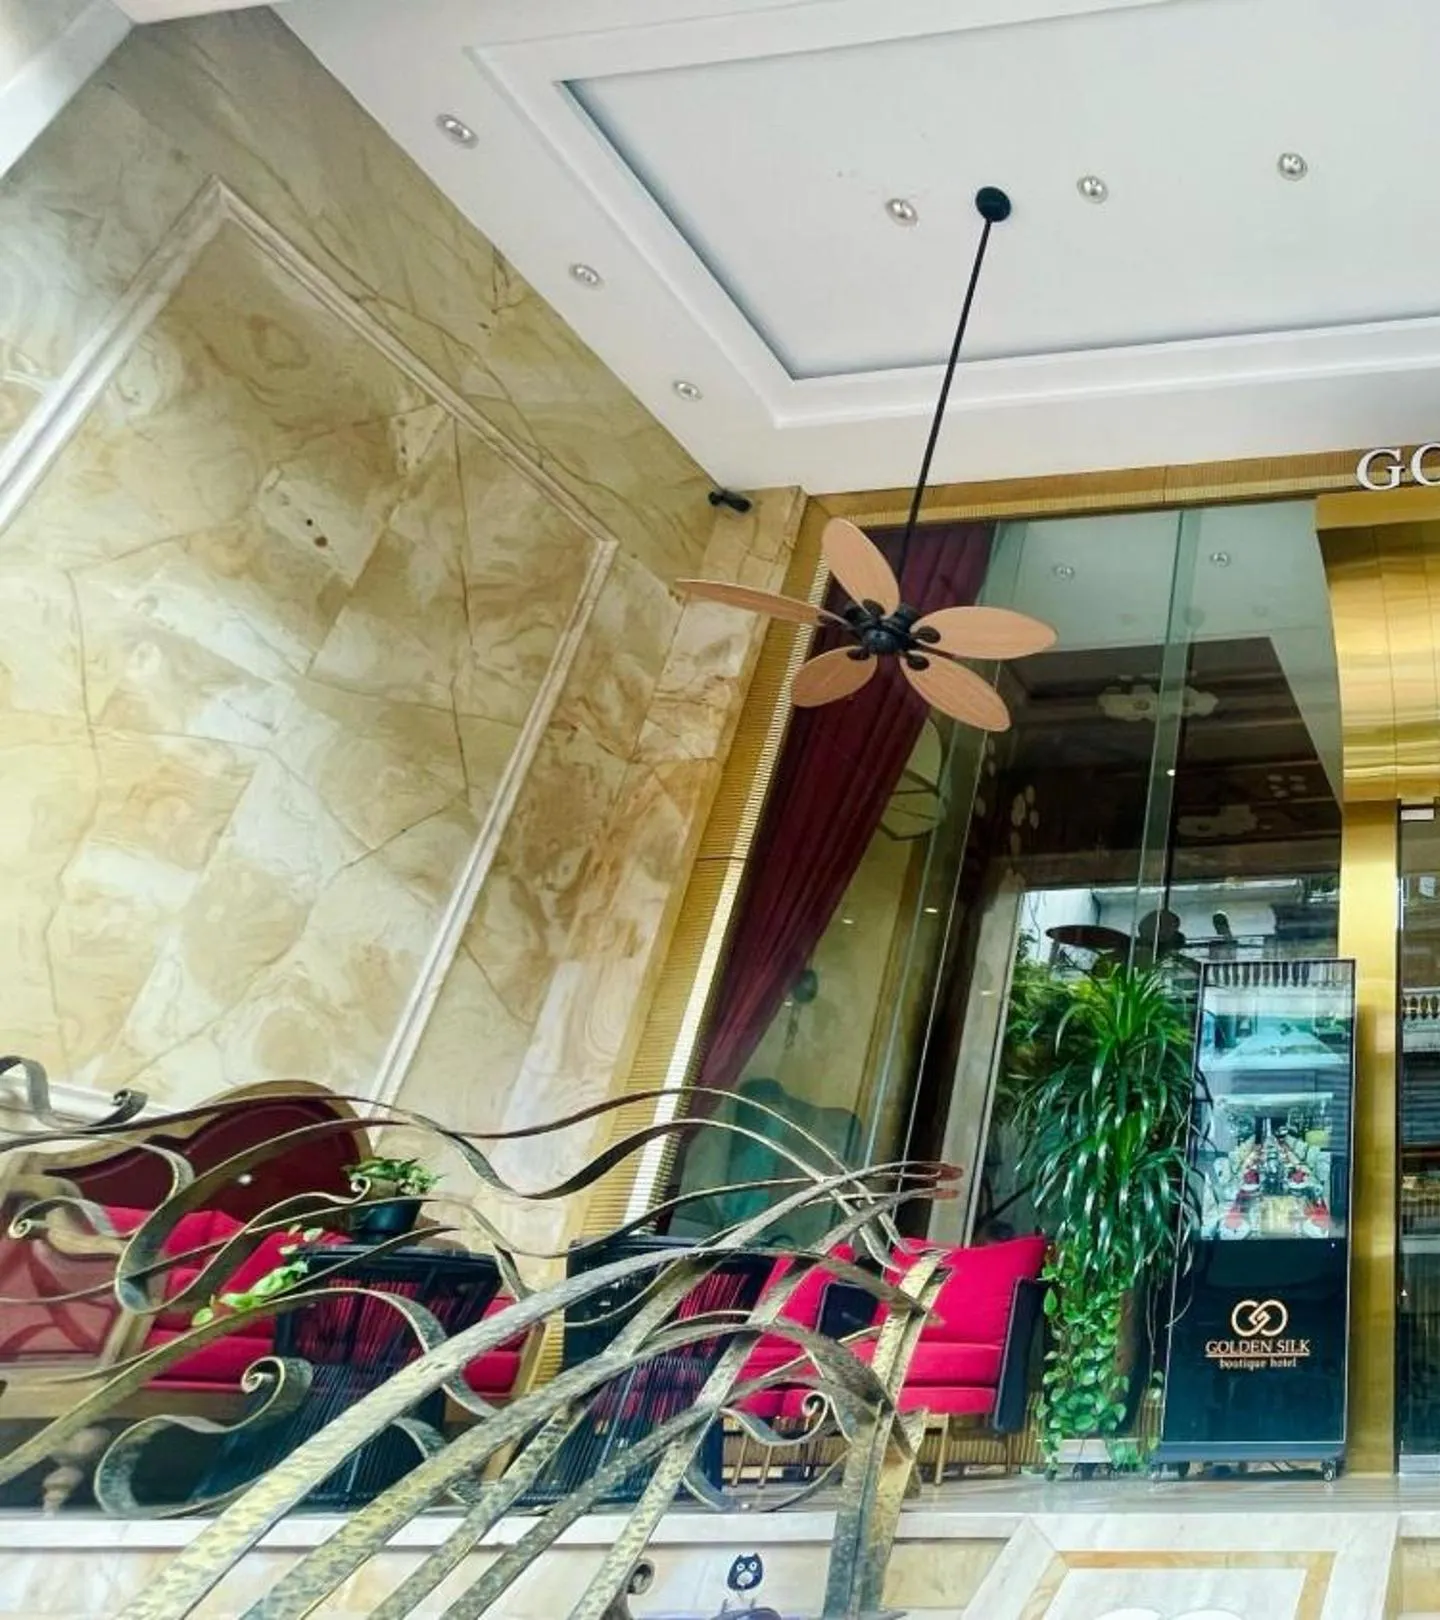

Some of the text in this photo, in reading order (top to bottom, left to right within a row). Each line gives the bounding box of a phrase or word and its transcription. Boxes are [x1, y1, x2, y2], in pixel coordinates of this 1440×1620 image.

[1205, 1338, 1310, 1354] GOLDEN SILK
[1219, 1356, 1297, 1372] boutique hotel
